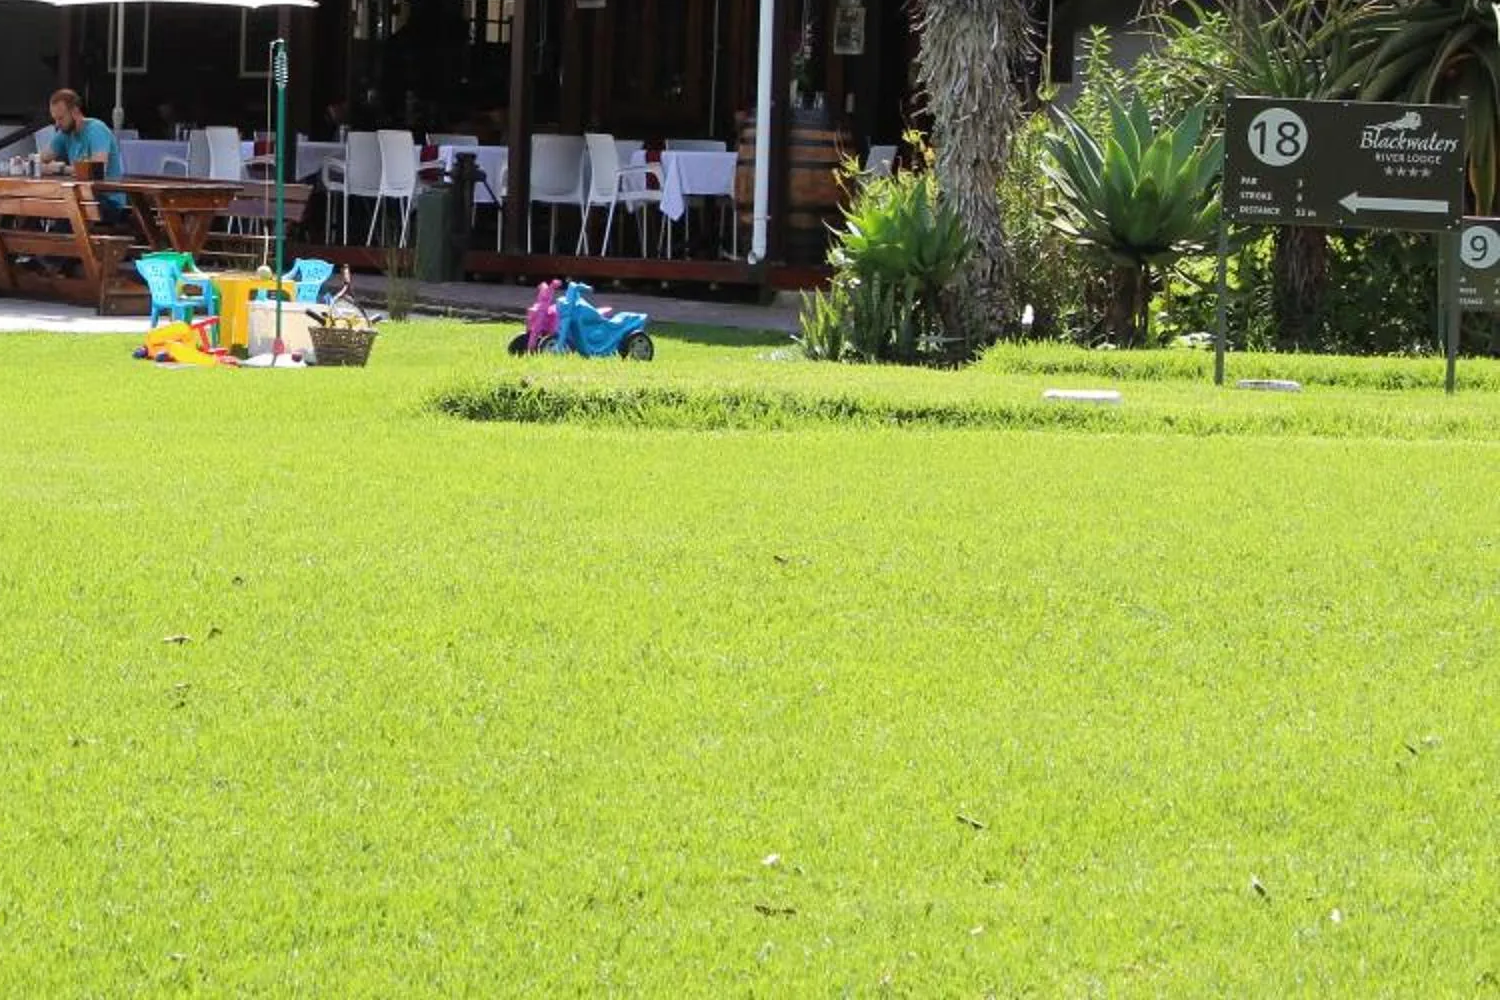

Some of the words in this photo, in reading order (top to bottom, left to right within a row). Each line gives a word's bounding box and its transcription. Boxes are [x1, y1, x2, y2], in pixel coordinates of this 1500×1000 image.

[1253, 120, 1301, 157] 18
[1360, 125, 1459, 152] Blackwaters
[1375, 152, 1405, 163] RIVER
[1239, 205, 1280, 215] DISTANCE
[1470, 235, 1488, 261] 9
